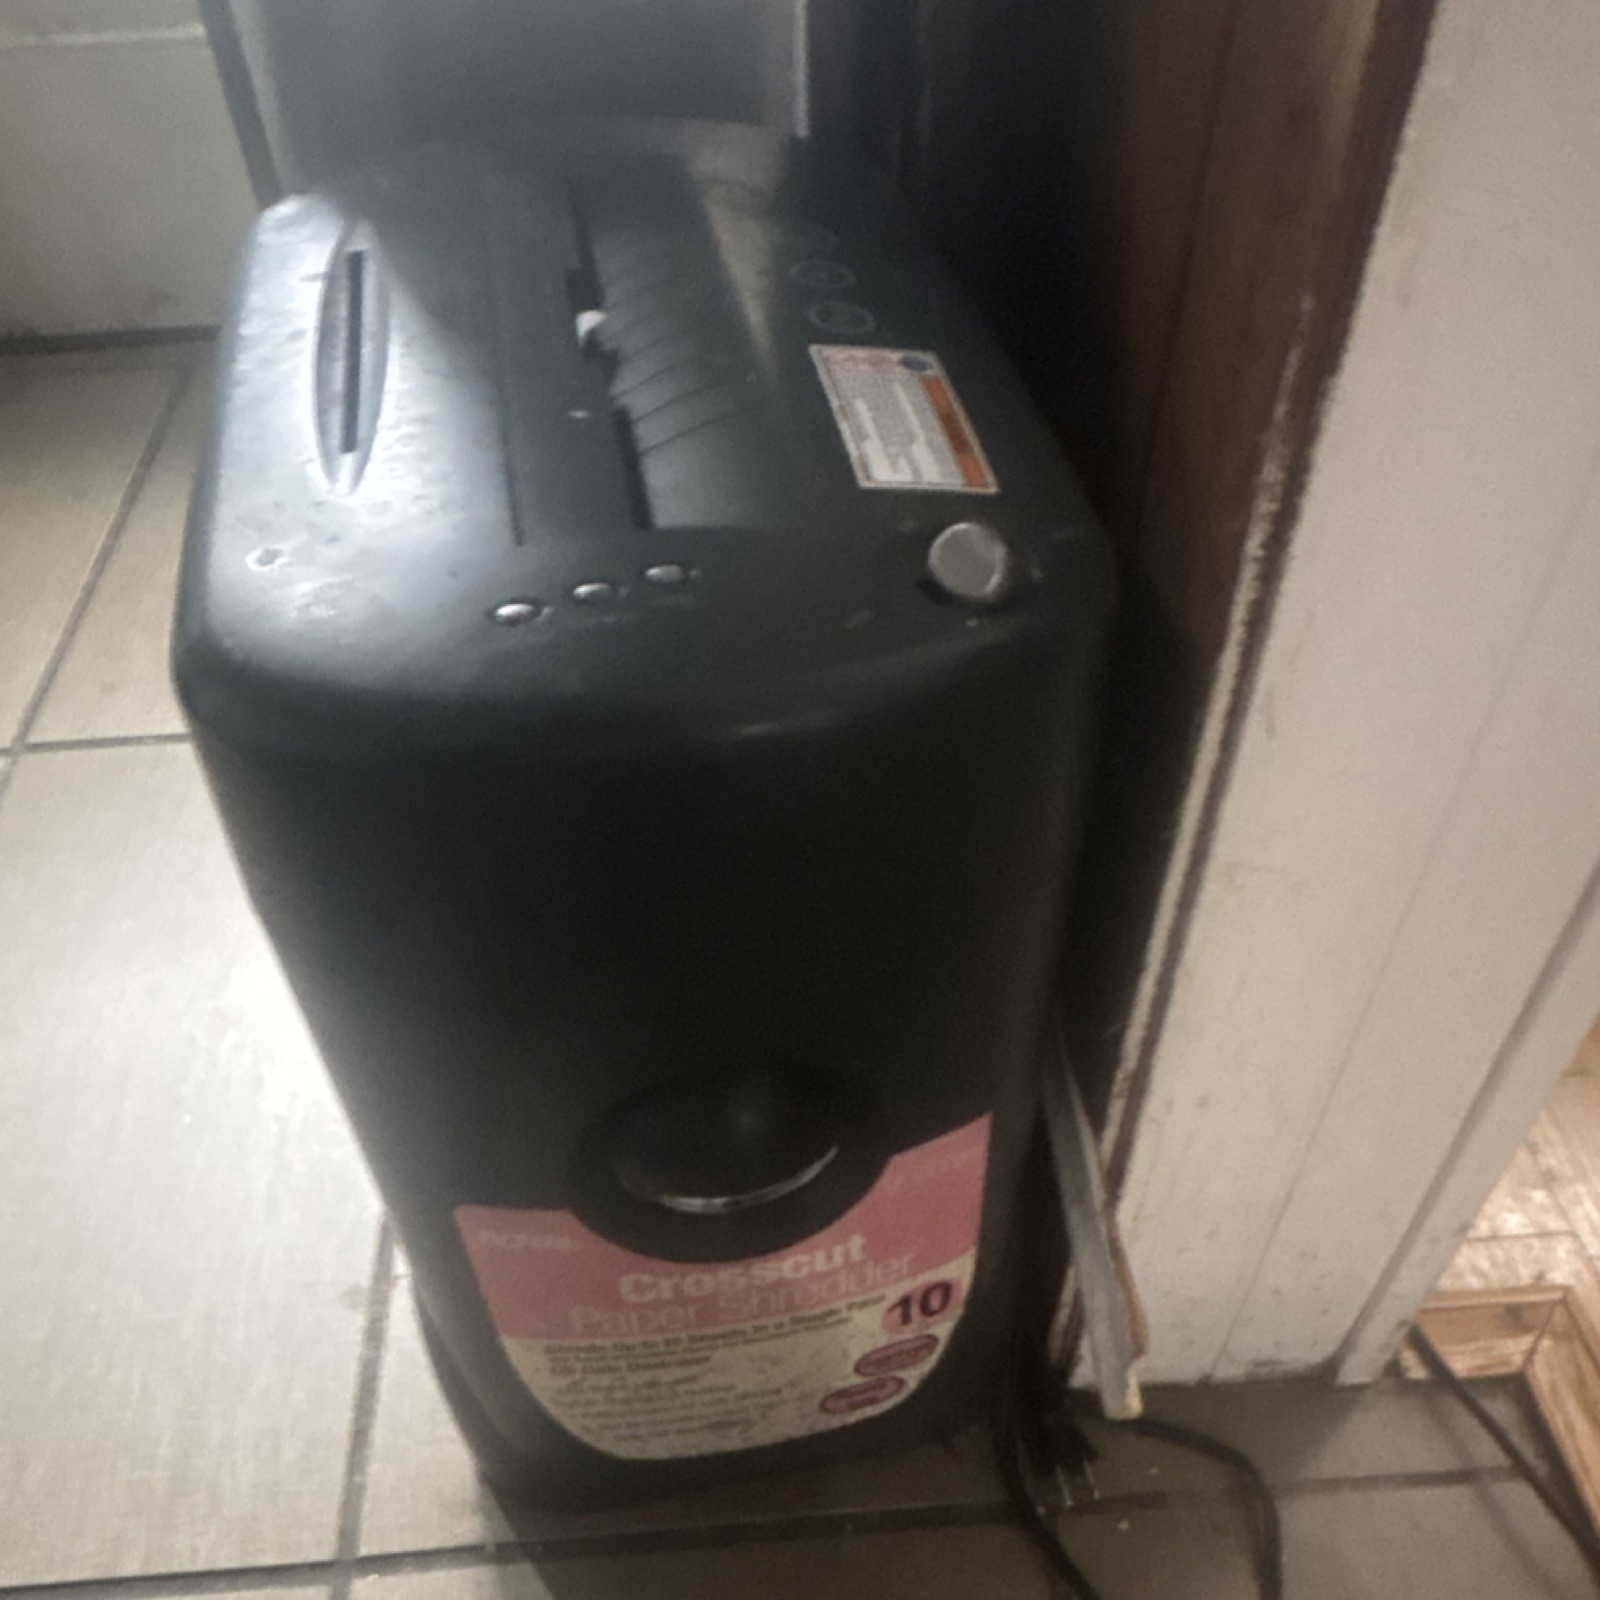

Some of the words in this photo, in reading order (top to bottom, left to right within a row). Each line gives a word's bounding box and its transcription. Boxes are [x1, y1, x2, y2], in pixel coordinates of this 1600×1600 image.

[571, 1302, 700, 1340] Paper
[717, 1252, 914, 1321] Shredder
[619, 1235, 866, 1303] Crosscut
[887, 1280, 953, 1327] 10
